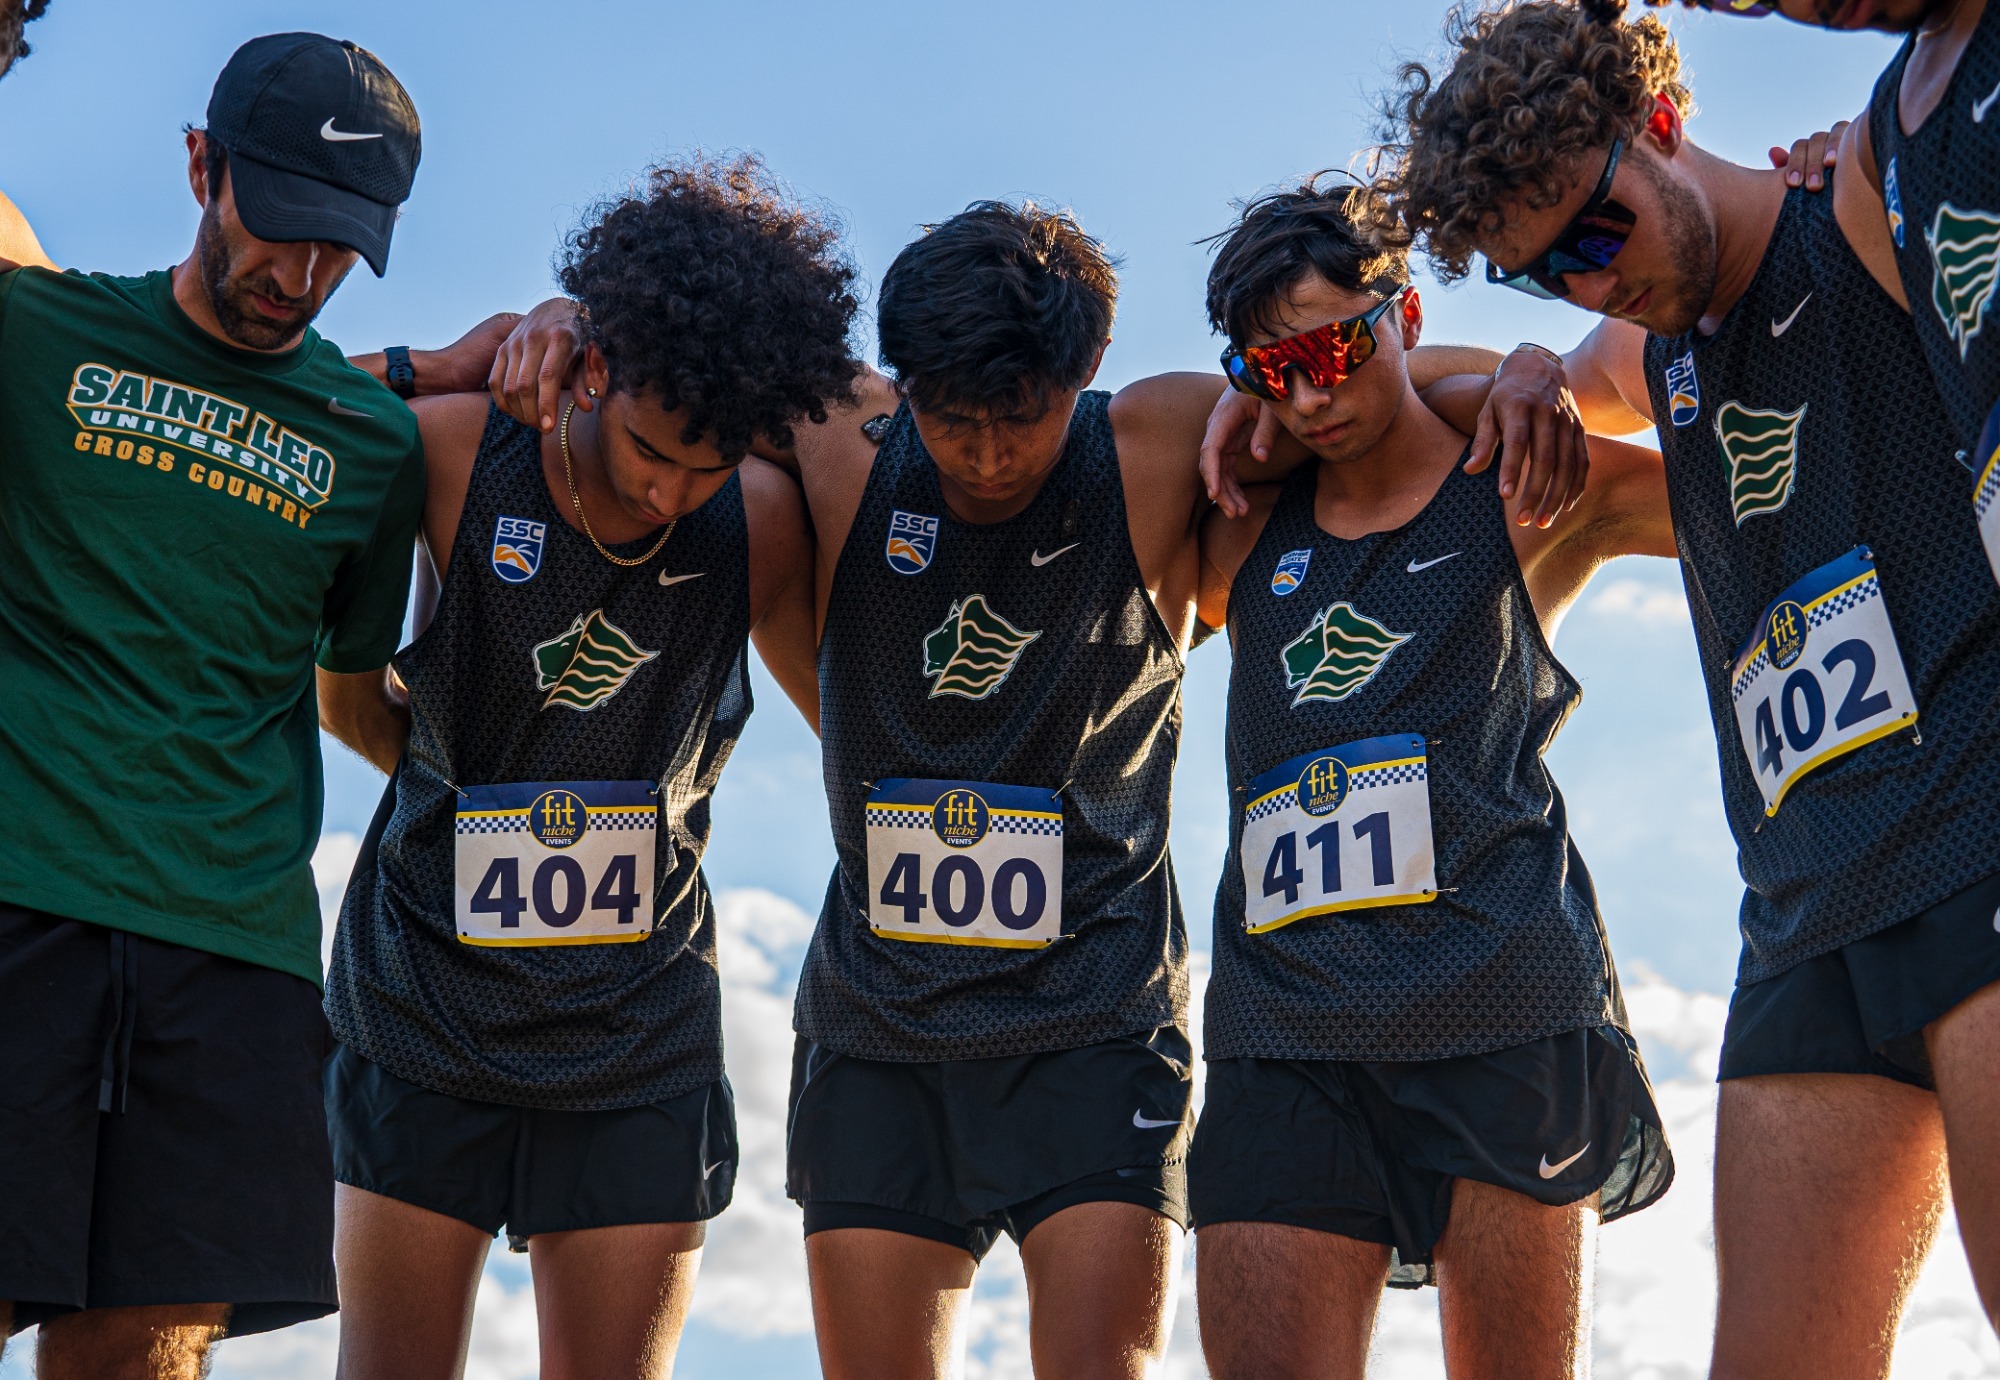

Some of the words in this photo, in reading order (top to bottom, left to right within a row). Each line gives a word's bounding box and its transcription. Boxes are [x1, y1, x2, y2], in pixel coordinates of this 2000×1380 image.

[69, 364, 247, 437] SAINT
[247, 412, 335, 495] LEO
[90, 410, 310, 499] UNIVERSITY
[74, 431, 175, 472] CROSS
[188, 462, 311, 530] COUNTRY
[498, 520, 544, 540] SSC
[893, 513, 936, 534] SSC
[1771, 606, 1798, 647] fit
[1775, 636, 1800, 660] niche
[1780, 650, 1800, 669] EVENTS
[1755, 638, 1893, 778] 402
[1307, 761, 1338, 796] fit
[541, 795, 576, 826] fit
[943, 794, 978, 826] fit
[1308, 791, 1339, 806] niche
[1311, 804, 1336, 815] EVENTS
[541, 824, 576, 836] niche
[943, 824, 978, 836] niche
[946, 837, 973, 845] EVENTS
[1262, 811, 1395, 906] 411
[470, 854, 641, 928] 404
[880, 852, 1047, 930] 400
